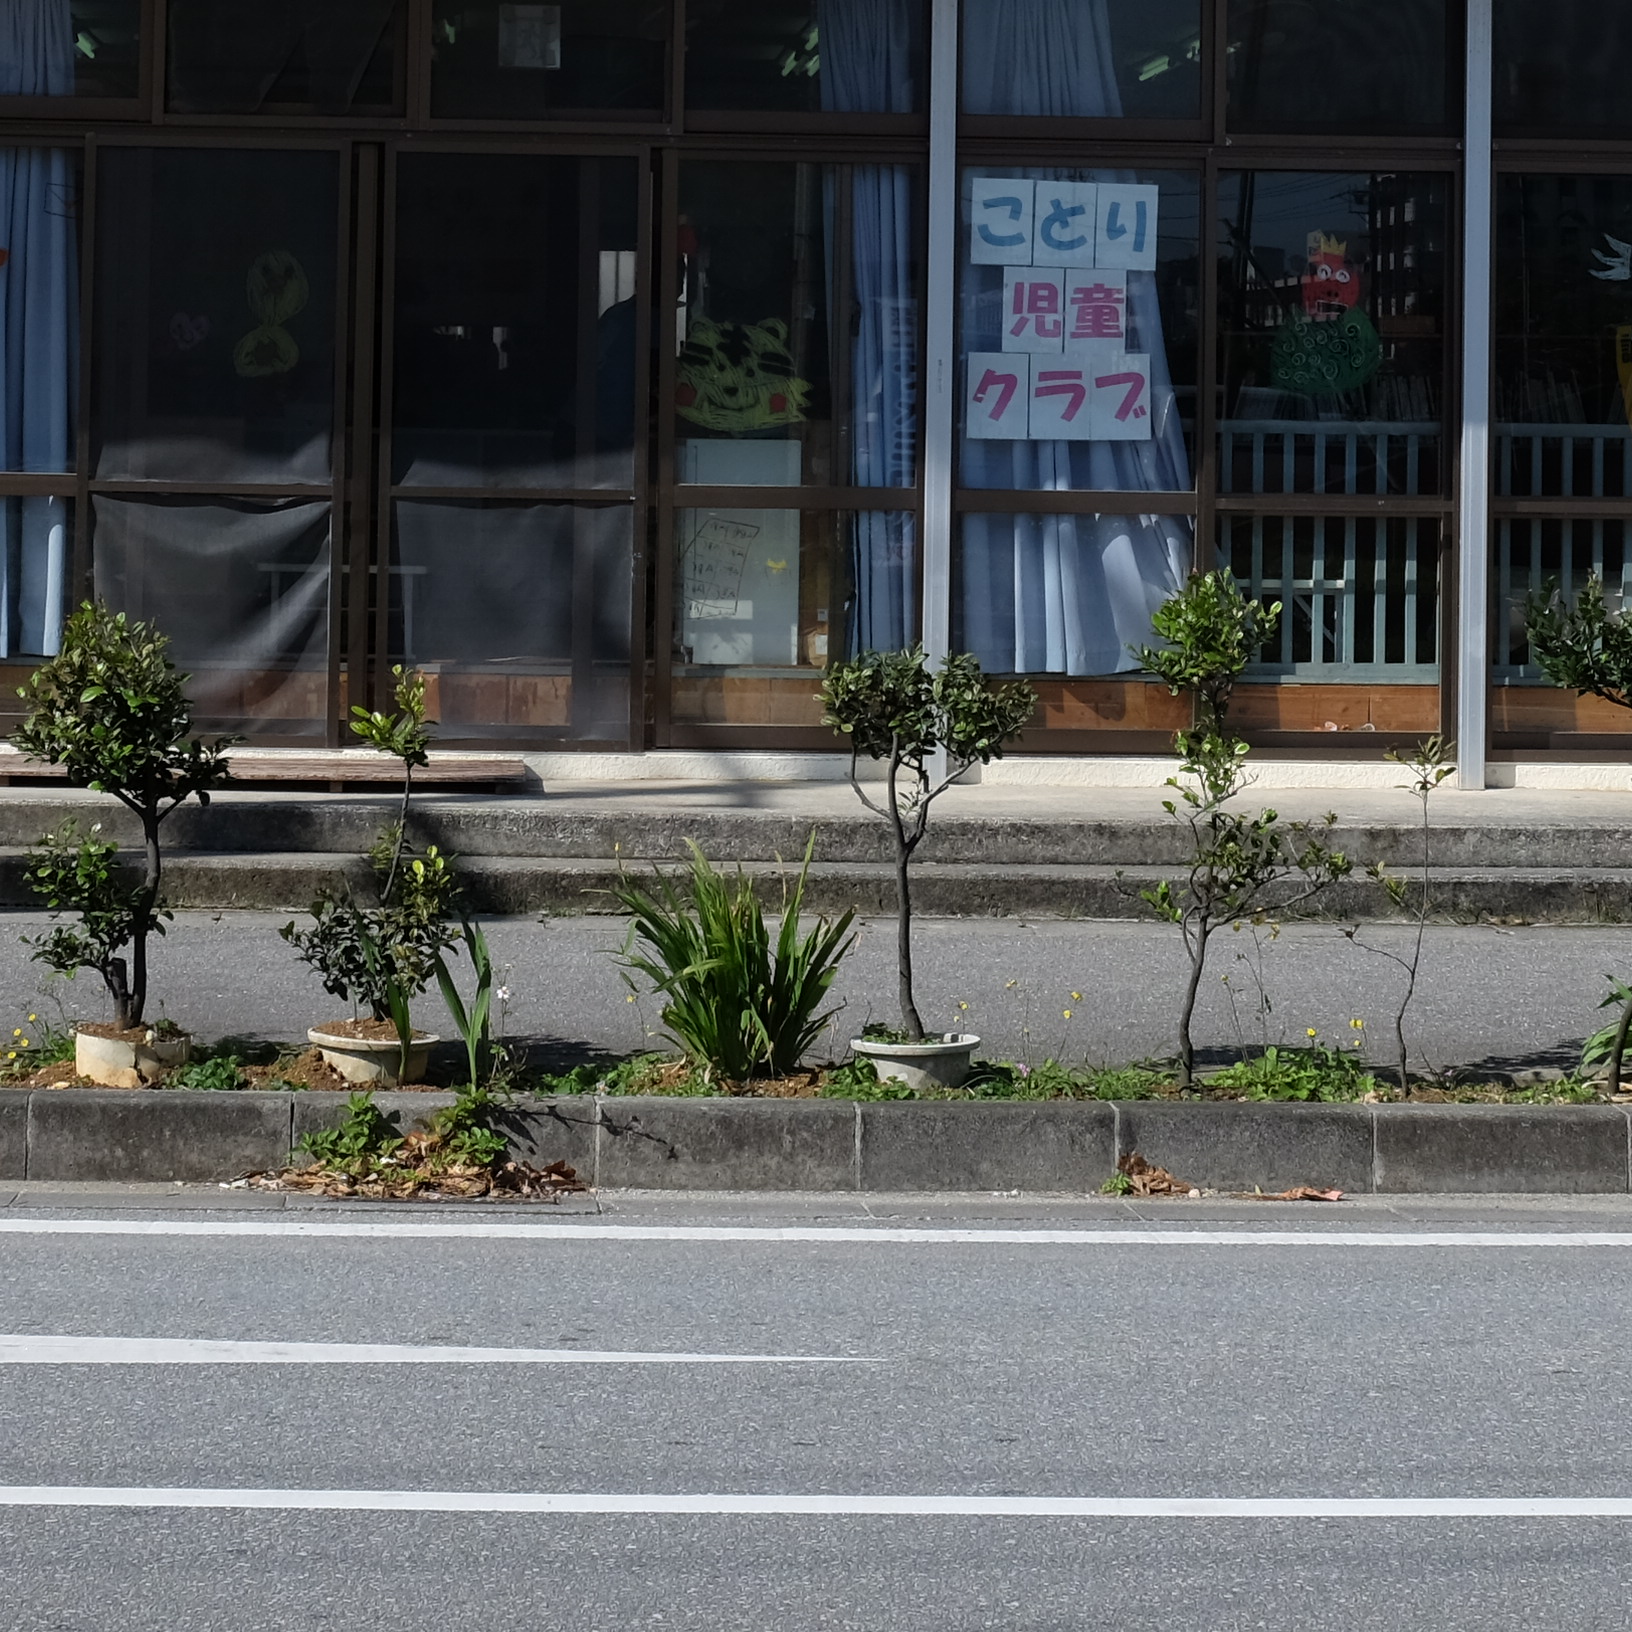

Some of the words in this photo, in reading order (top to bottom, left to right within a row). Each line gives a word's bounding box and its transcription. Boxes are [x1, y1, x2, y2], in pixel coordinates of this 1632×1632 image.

[977, 196, 1147, 252] ことり
[1010, 282, 1124, 339] 児童
[972, 369, 1147, 422] クラブ
